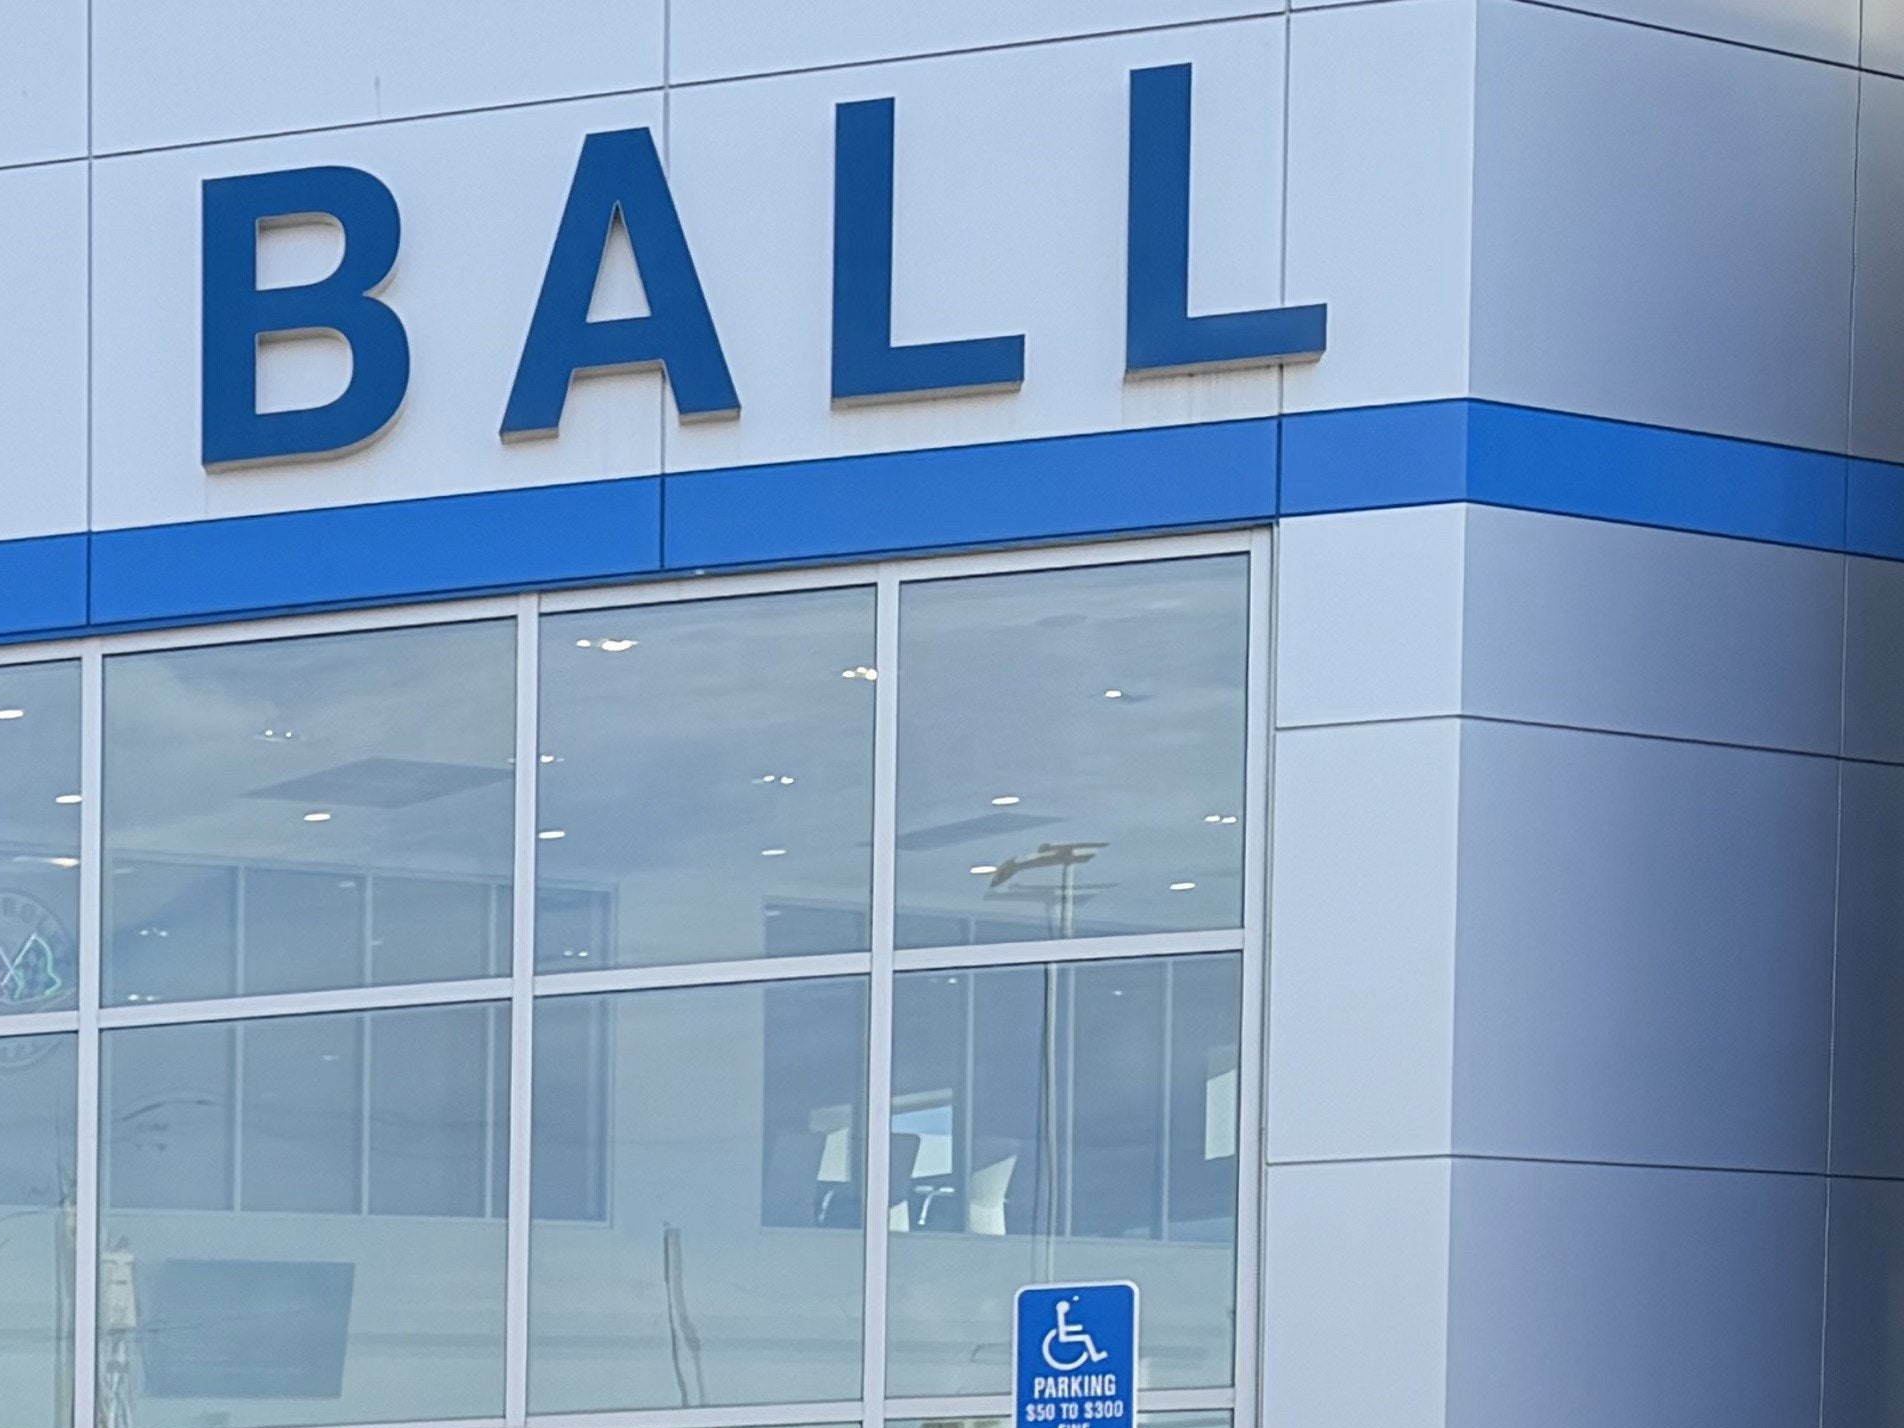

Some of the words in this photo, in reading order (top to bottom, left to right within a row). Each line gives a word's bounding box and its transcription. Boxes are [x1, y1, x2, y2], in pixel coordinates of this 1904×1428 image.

[201, 62, 1328, 473] BALL
[1034, 1374, 1116, 1399] PARKING
[1026, 1404, 1054, 1421] $50
[1060, 1402, 1079, 1420] TO
[1084, 1400, 1124, 1419] $300
